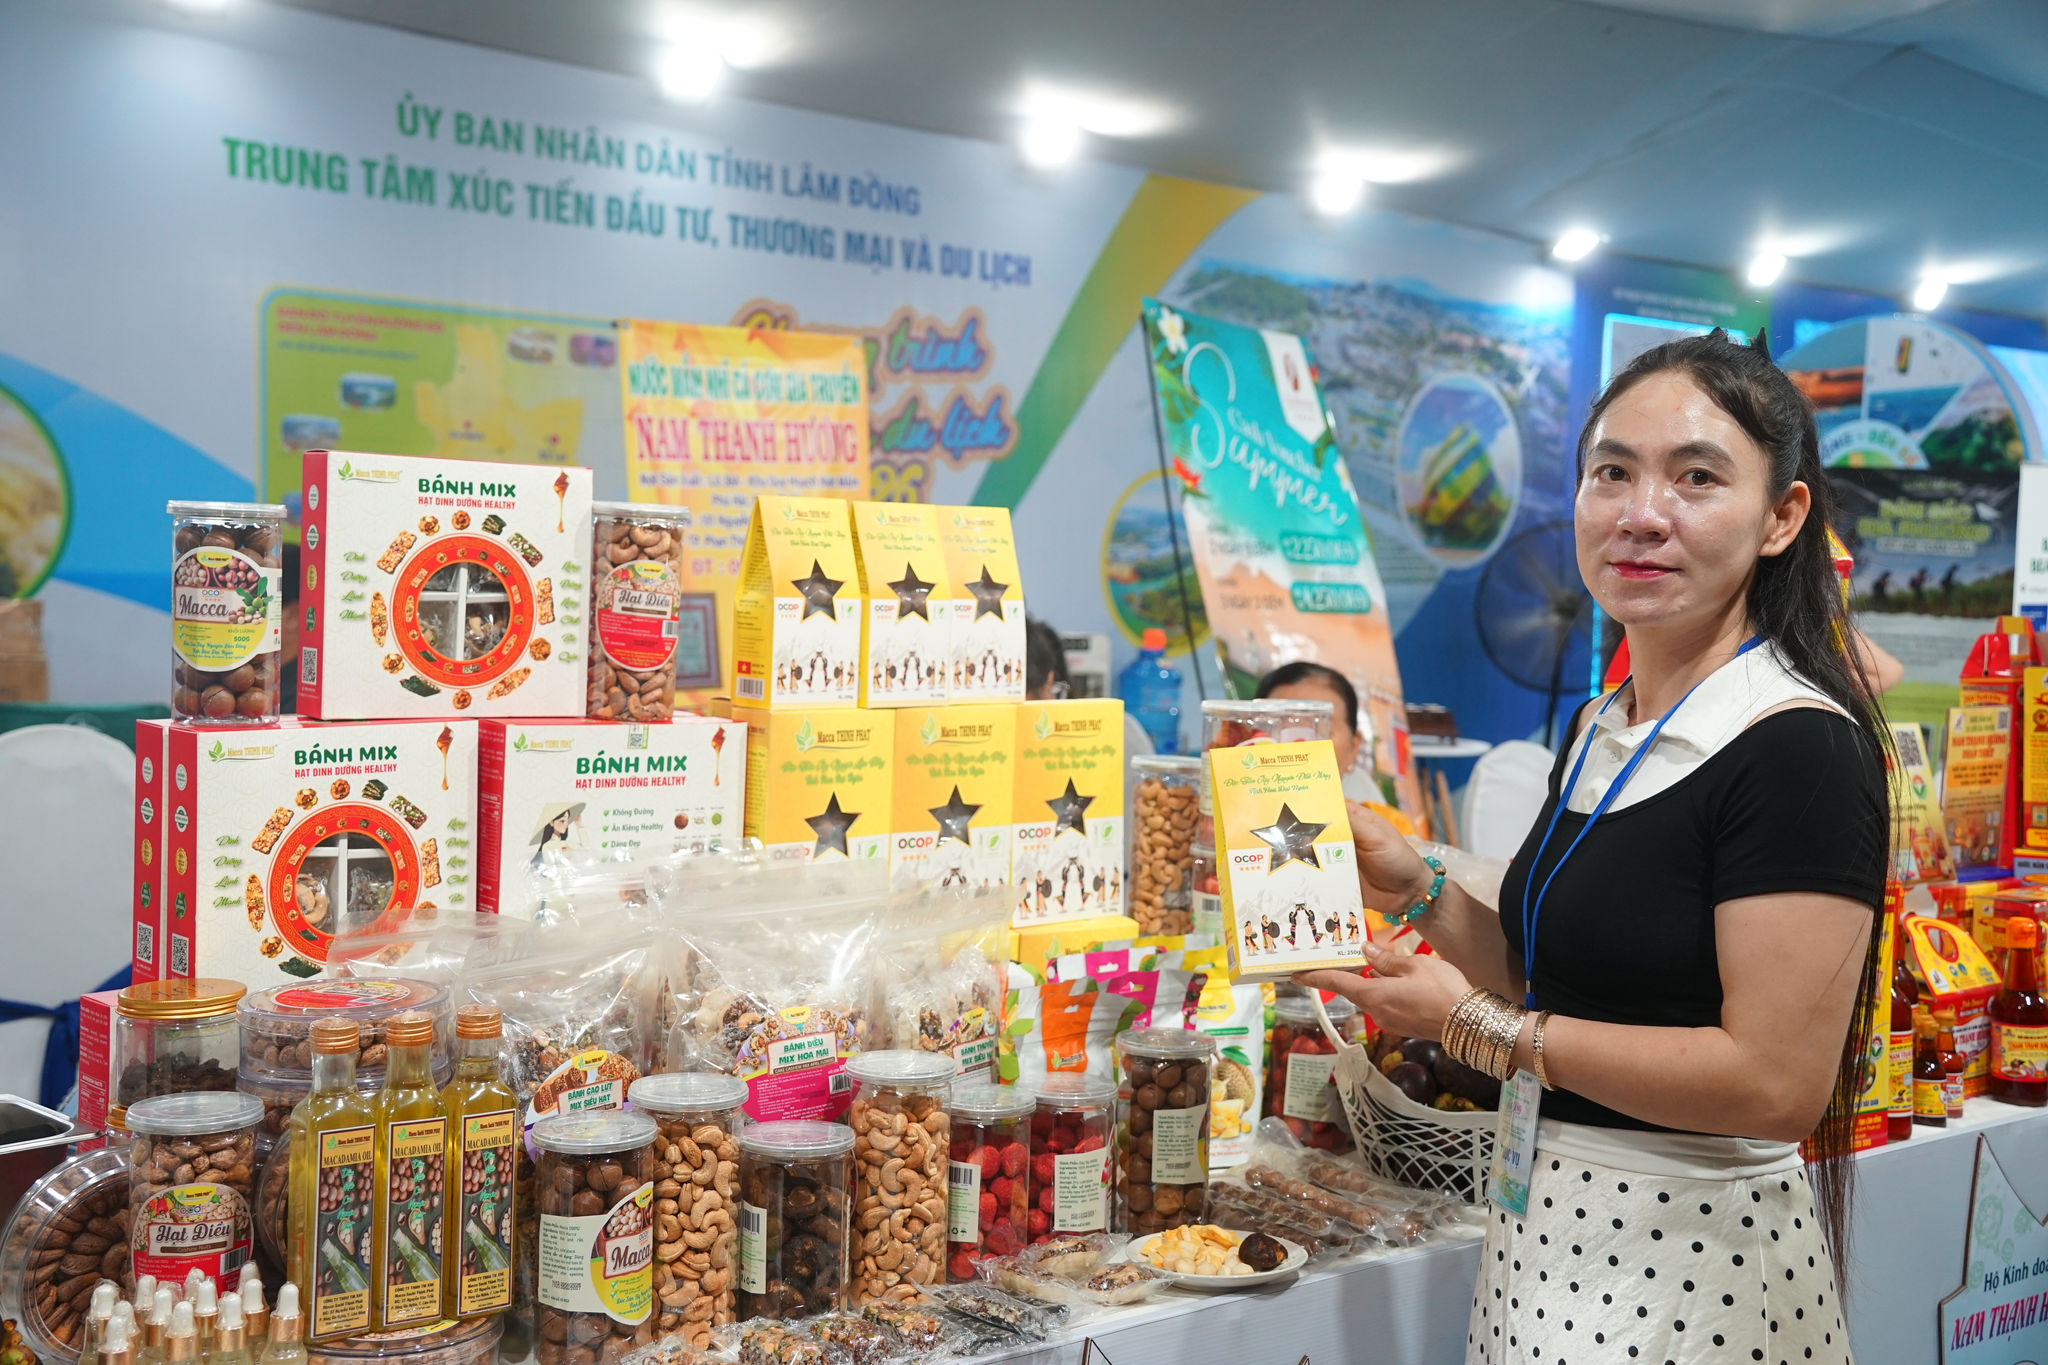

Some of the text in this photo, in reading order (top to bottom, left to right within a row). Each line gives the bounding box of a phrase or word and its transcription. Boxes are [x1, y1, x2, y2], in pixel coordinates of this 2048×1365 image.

[398, 93, 442, 138] ỦY
[454, 113, 524, 154] BAN
[536, 126, 626, 169] NHÂN
[635, 140, 696, 180] DÂN
[782, 162, 840, 201] LÂM
[848, 169, 921, 215] ĐỒNG
[223, 136, 348, 192] TRUNG
[361, 156, 436, 206] TÂM
[450, 169, 514, 217] XÚC
[526, 177, 595, 227] TIẾN
[729, 212, 836, 261] THƯƠNG
[845, 230, 893, 274] MẠI
[901, 234, 933, 274] VÀ
[941, 244, 971, 279] DU
[980, 250, 1032, 289] LỊCH
[636, 415, 691, 461] NAM
[418, 474, 516, 498] BÁNH MIX
[418, 496, 434, 508] HẠT
[436, 496, 454, 507] DINH
[484, 500, 516, 510] HEALTHY
[179, 594, 229, 616] Macca
[618, 590, 642, 607] Hạt
[778, 603, 799, 611] OCOP
[874, 604, 894, 612] OCOP
[941, 726, 957, 737] Macca
[1054, 721, 1070, 732] Macca
[817, 731, 835, 743] Macca
[294, 743, 398, 765] BÁNH MIX
[1260, 757, 1276, 765] Macca
[576, 750, 687, 774] BÁNH MIX
[295, 763, 397, 779] HẠT DINH DƯỠNG HEALTHY
[576, 775, 686, 791] HẠT DINH DƯỠNG HEALTHY
[612, 808, 654, 817] Không Đường
[641, 823, 664, 831] Healthy
[1019, 828, 1051, 839] OCOP
[898, 837, 932, 849] OCOP
[1234, 854, 1264, 864] OCOP
[784, 1041, 806, 1053] BÁNH
[779, 1048, 829, 1064] MIX HOA MAI
[568, 1089, 585, 1100] BÁNH
[570, 1101, 582, 1110] MIX
[467, 1136, 511, 1149] MACADAMIA OIL
[394, 1143, 442, 1157] MACADAMIA OIL
[324, 1151, 372, 1165] MACADAMIA OIL
[156, 1225, 187, 1246] Hạt
[612, 1244, 650, 1271] Macca
[1984, 1271, 2000, 1294] Hộ
[2003, 1262, 2029, 1287] Kinh
[1951, 1310, 1986, 1352] NAM
[1989, 1293, 2040, 1342] THẠNH
